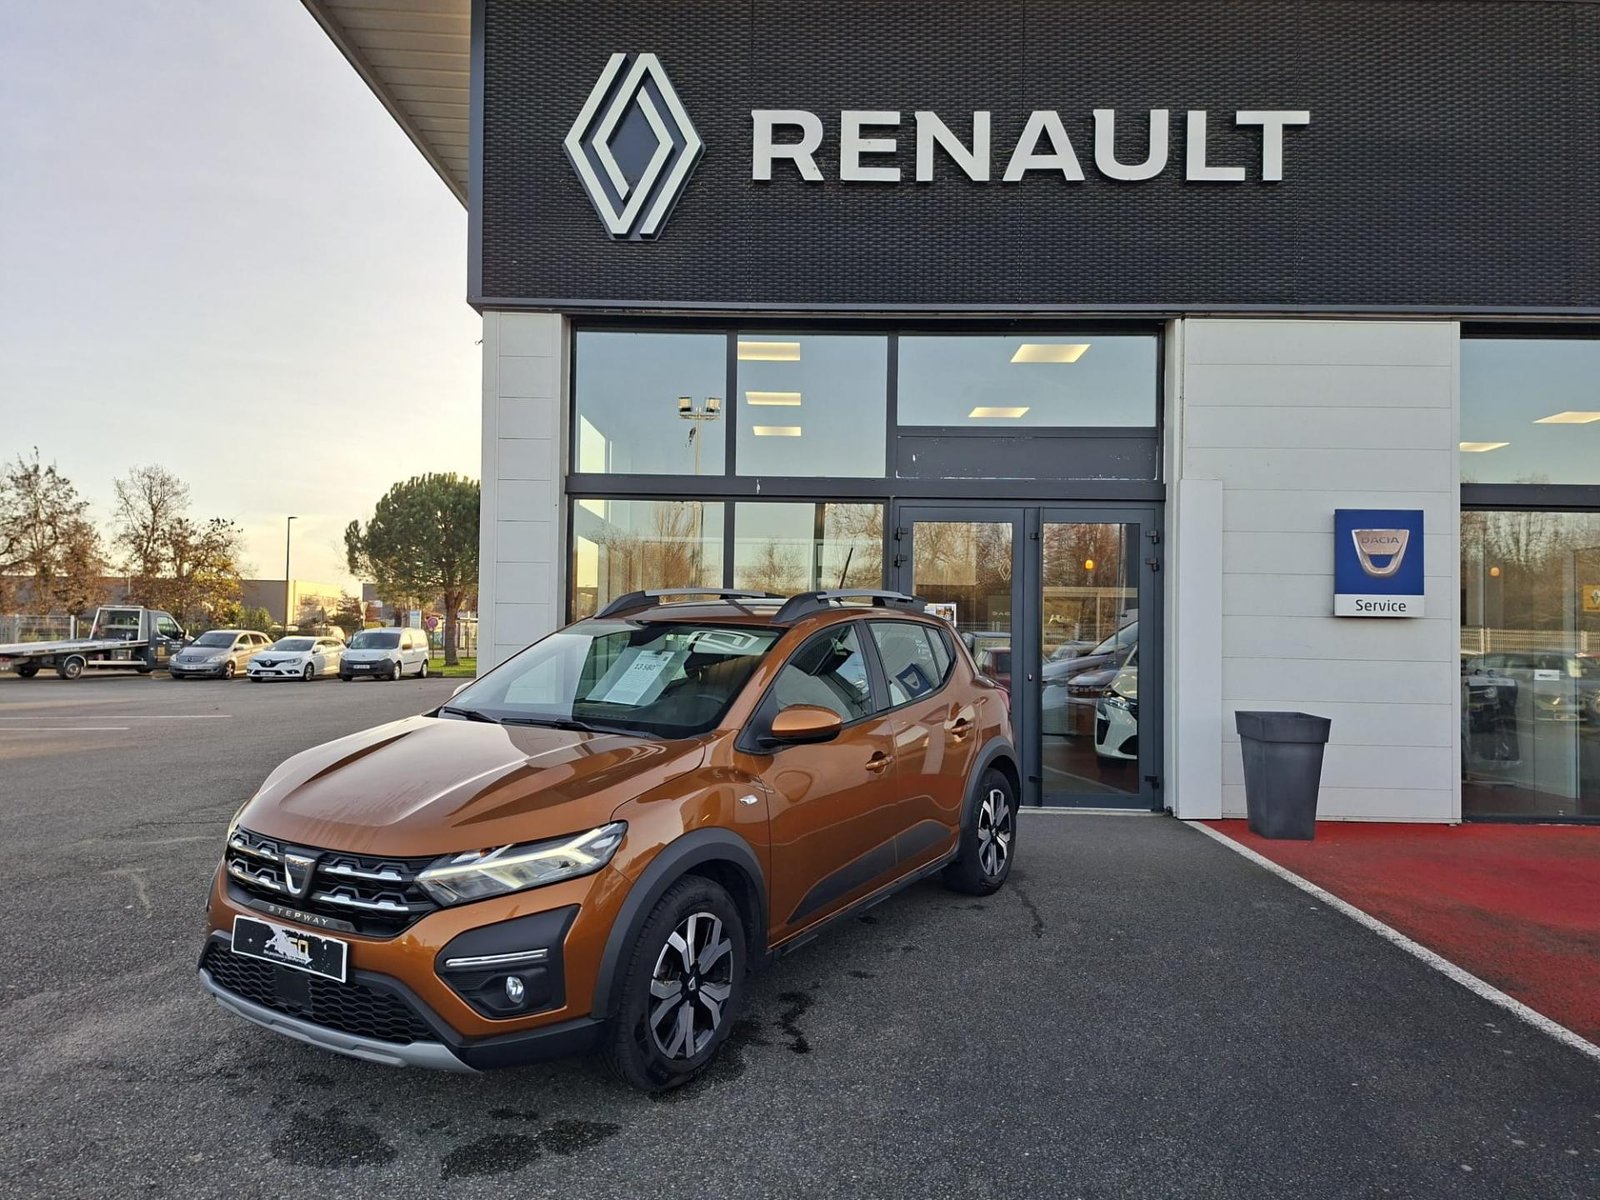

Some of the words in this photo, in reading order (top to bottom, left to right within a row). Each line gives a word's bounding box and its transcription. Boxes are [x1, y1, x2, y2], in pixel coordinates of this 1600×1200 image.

[751, 109, 1311, 182] RENAULT
[1361, 536, 1400, 544] DACIA
[1355, 599, 1407, 612] Service
[268, 905, 328, 926] STEPWAY
